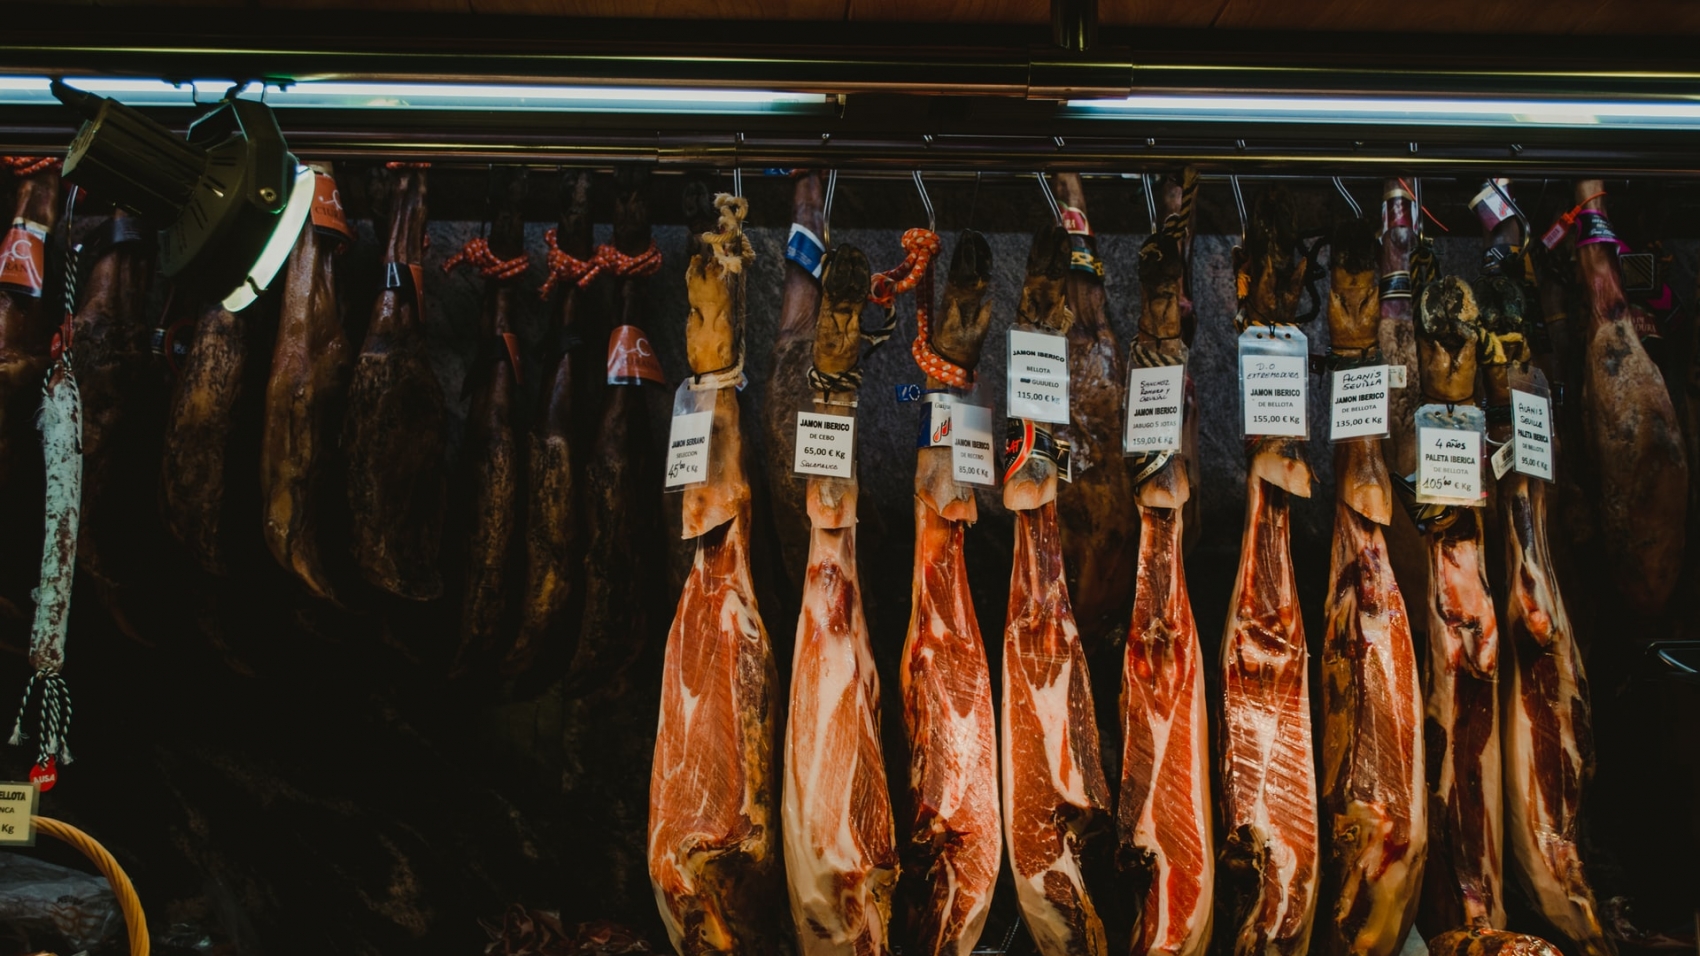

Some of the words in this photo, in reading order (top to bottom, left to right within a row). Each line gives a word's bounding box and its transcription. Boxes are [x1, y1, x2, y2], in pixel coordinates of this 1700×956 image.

[1037, 352, 1065, 362] IBERICO
[1017, 391, 1043, 400] 115,00
[1275, 389, 1300, 397] IBERICO
[1335, 395, 1357, 404] JAMON
[1359, 392, 1384, 402] IBERICO
[1134, 408, 1153, 416] JAMON
[1155, 406, 1177, 415] IBERICO
[1254, 415, 1280, 423] 155,00
[1290, 416, 1300, 424] Kg
[1336, 419, 1362, 427] 135,00
[800, 419, 822, 428] JAMON
[824, 421, 850, 431] IBERICO
[1133, 437, 1156, 445] 159,00
[1518, 429, 1532, 438] PALETA
[1533, 433, 1548, 443] IBERICA
[672, 439, 685, 448] JAMON
[686, 436, 705, 446] SERRANO
[955, 438, 971, 447] JAMON
[972, 441, 989, 450] IBERICO
[1435, 438, 1442, 449] 4
[804, 447, 826, 456] 65,00
[836, 450, 845, 459] Kg
[1425, 454, 1448, 462] PALETA
[1450, 456, 1475, 464] IBERICA
[1522, 457, 1535, 466] 95,00
[1541, 462, 1547, 471] Kg
[959, 466, 975, 474] 85,00
[981, 469, 989, 478] Kg
[1462, 482, 1471, 491] Kg
[1, 824, 14, 834] Kg
